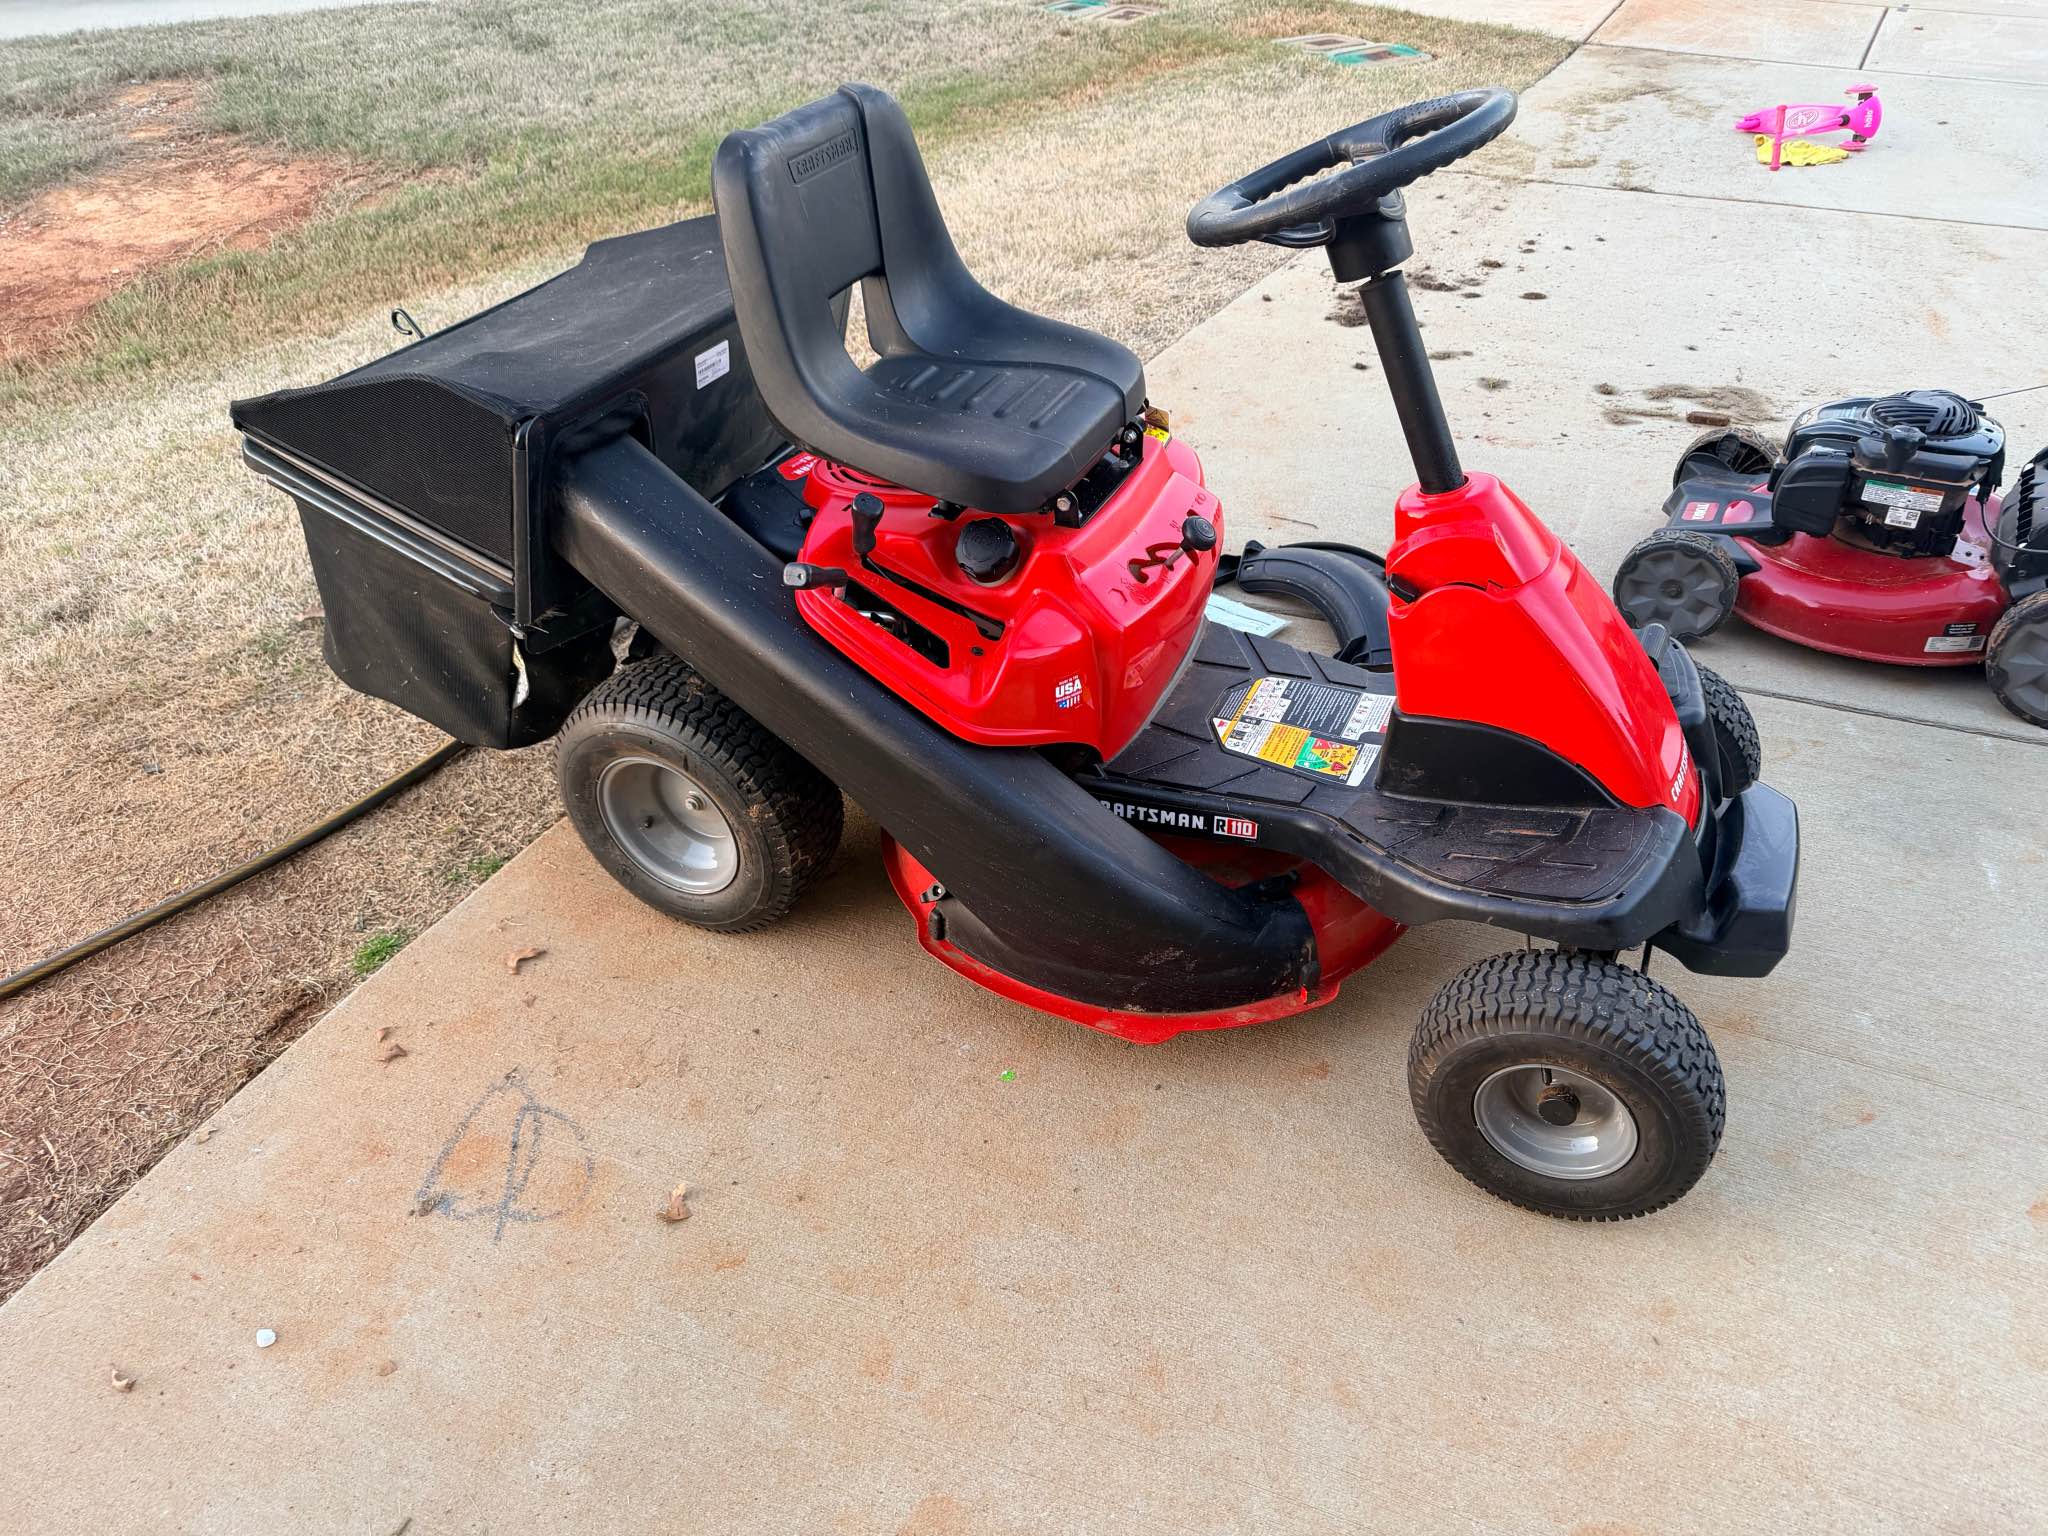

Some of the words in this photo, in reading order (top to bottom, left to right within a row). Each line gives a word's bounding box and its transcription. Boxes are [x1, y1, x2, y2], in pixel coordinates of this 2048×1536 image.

[795, 135, 853, 176] CRAFTSMAN
[1055, 678, 1082, 699] USA
[1101, 800, 1205, 830] RAFTSMAN
